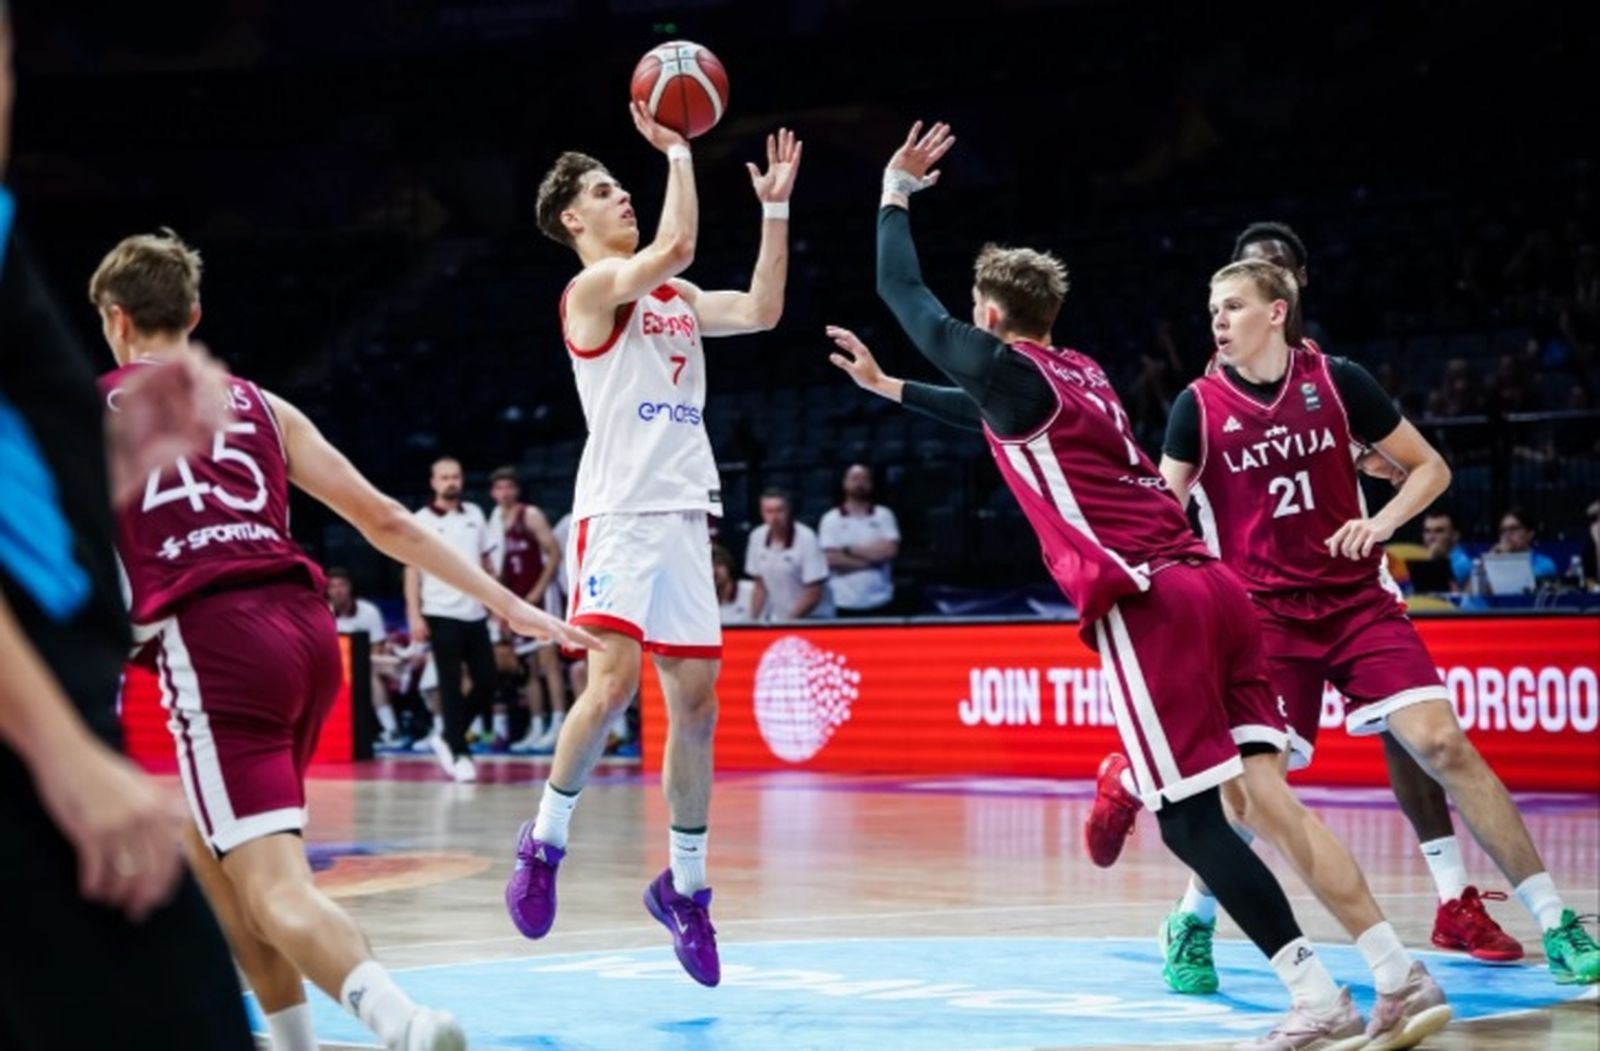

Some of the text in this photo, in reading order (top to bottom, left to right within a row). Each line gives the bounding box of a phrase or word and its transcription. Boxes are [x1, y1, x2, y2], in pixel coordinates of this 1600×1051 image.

[670, 356, 686, 385] 7
[142, 421, 268, 513] 45
[1223, 427, 1336, 473] LATVIJA
[1268, 470, 1315, 519] 21
[958, 667, 1041, 726] JOIN
[1435, 666, 1599, 733] ORGOO
